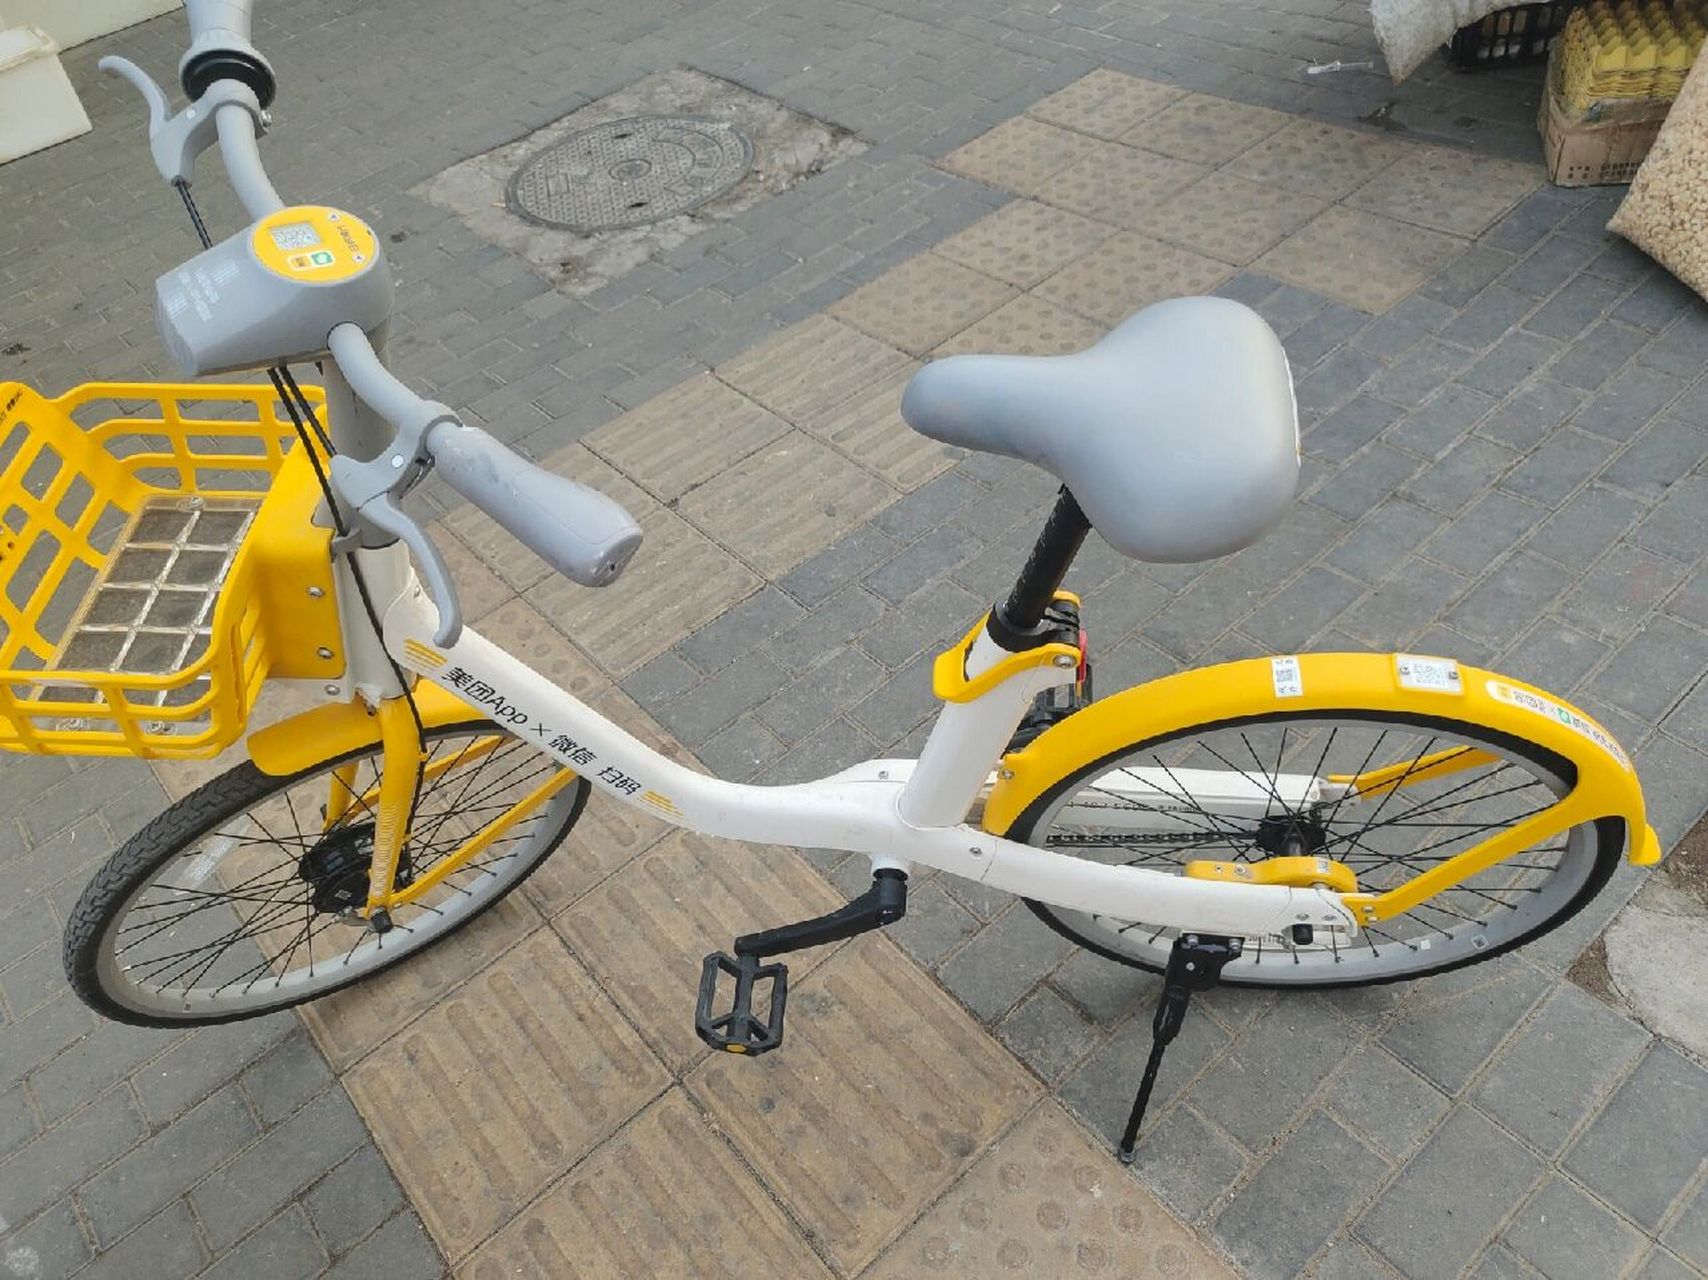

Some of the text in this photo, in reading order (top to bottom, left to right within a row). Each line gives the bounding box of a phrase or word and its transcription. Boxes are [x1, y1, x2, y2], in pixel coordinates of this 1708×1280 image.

[442, 666, 528, 725] 美团App
[548, 733, 597, 766] 微信
[596, 765, 642, 796] 扫码
